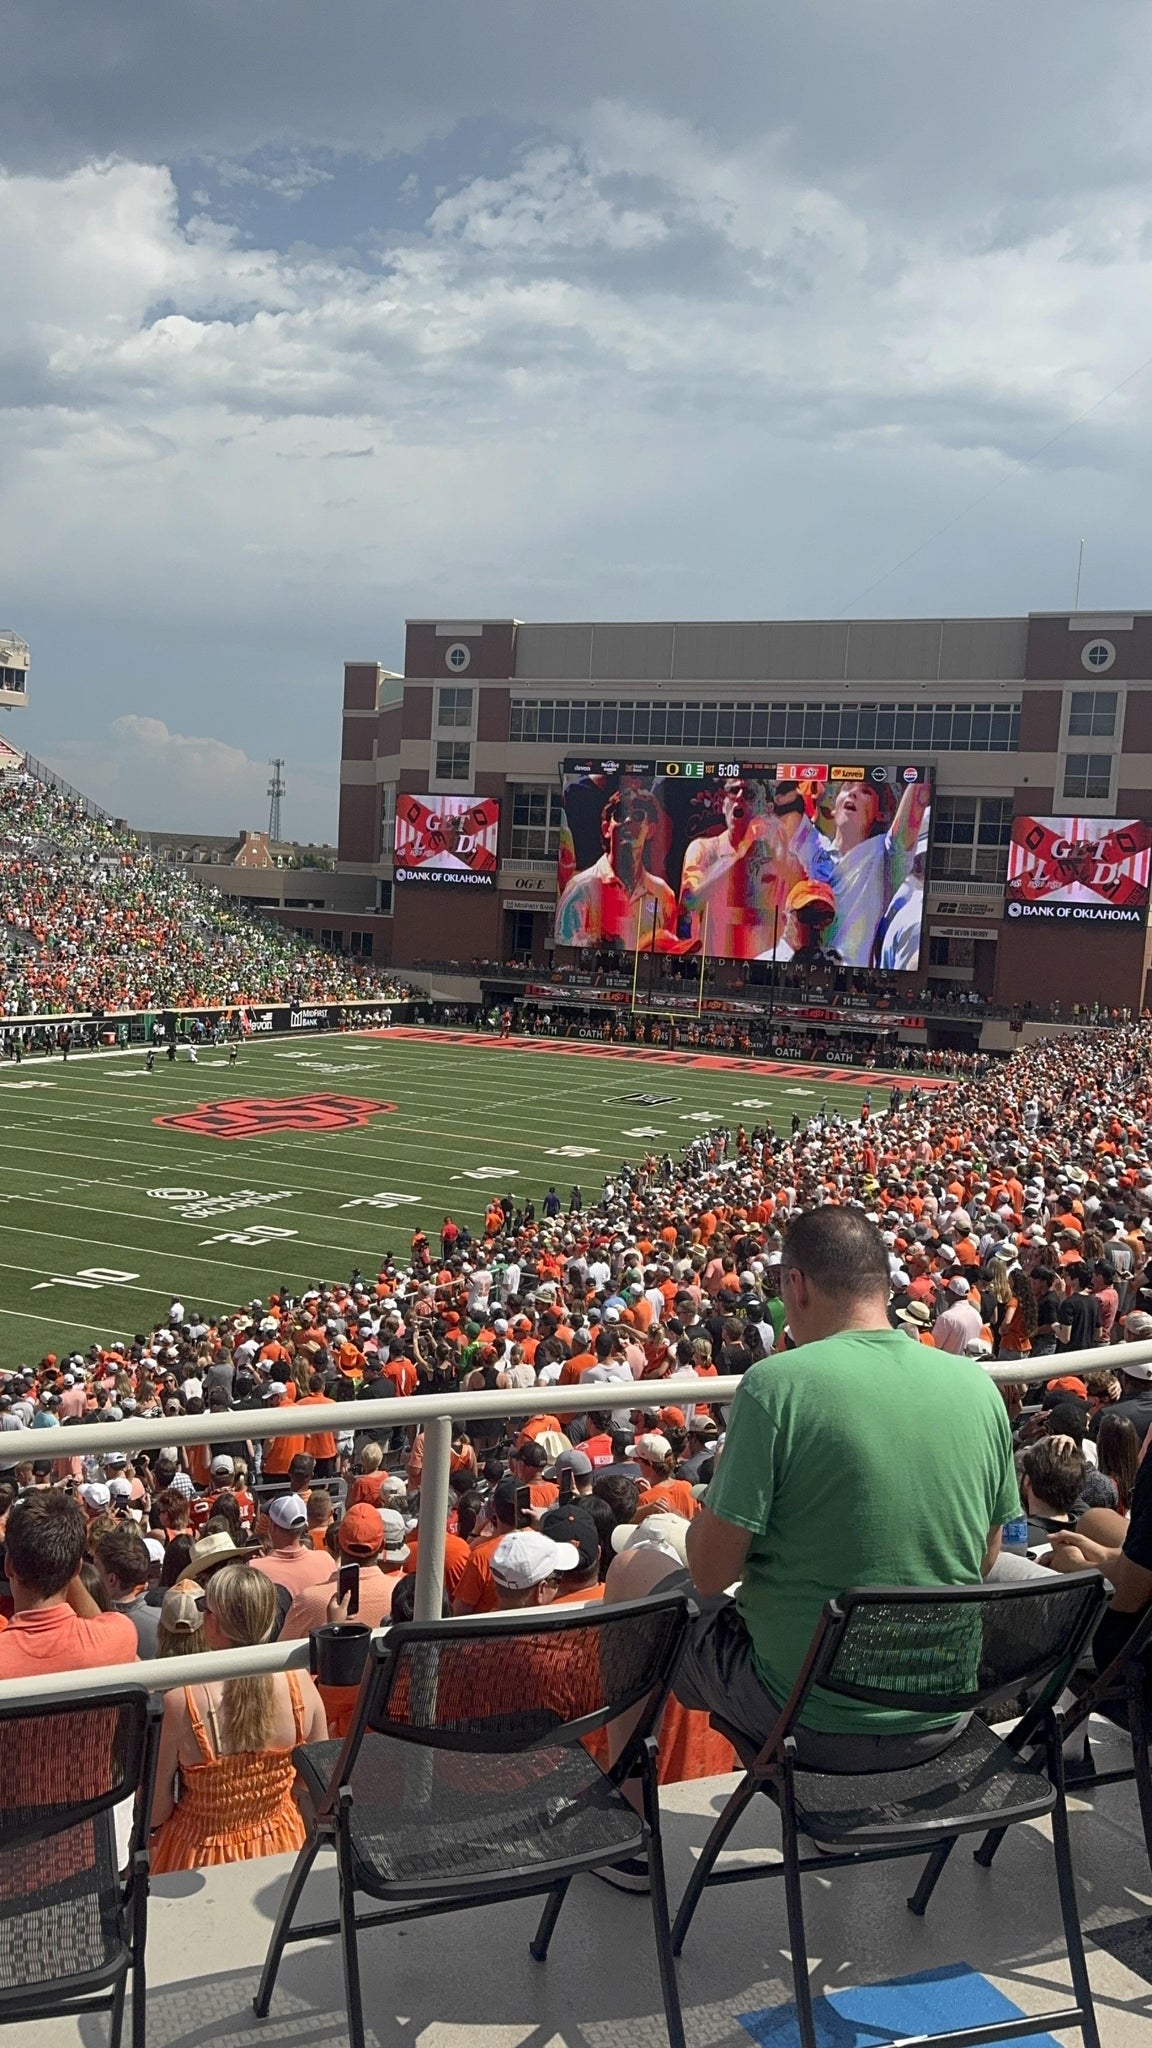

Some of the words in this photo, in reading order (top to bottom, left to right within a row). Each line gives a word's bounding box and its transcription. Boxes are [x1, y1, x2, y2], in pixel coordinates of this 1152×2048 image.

[685, 763, 692, 775] 0
[718, 764, 739, 776] 5:06
[407, 871, 430, 880] BANK
[431, 873, 443, 881] OF
[443, 873, 492, 884] OKLAHOMA
[1023, 905, 1055, 917] BANK
[1056, 907, 1071, 918] OF
[1073, 909, 1140, 921] OKLAHOMA
[582, 949, 627, 958] GARY
[642, 952, 650, 960] &
[666, 955, 750, 968] CLAUDIA
[767, 962, 888, 978] HUMPHREYS
[303, 1018, 318, 1026] BANK
[579, 1029, 603, 1038] OATH
[775, 1047, 801, 1057] OATH
[826, 1052, 853, 1062] OATH
[168, 1195, 239, 1211] BANK
[181, 1191, 303, 1218] OKLAHOMA
[349, 1192, 422, 1209] 30
[213, 1225, 299, 1246] 20
[50, 1267, 140, 1289] 10
